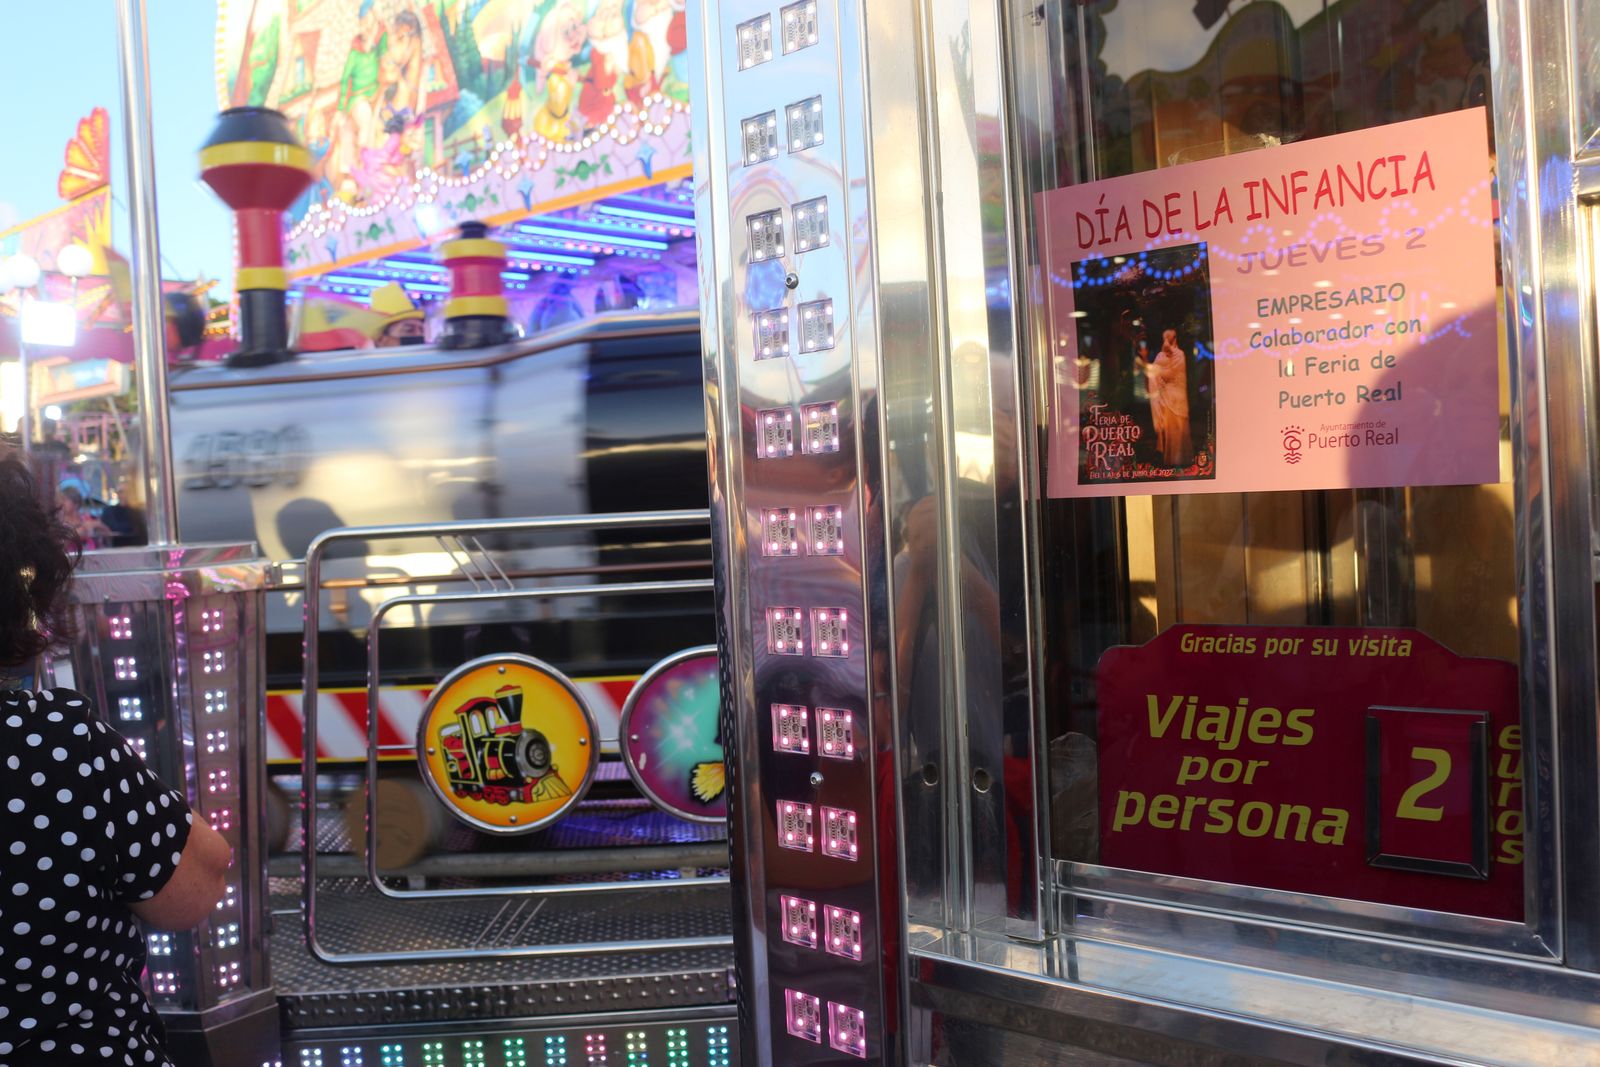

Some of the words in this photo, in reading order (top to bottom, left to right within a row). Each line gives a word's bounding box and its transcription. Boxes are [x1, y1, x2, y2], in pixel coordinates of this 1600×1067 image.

[1075, 193, 1132, 250] DÍA
[1143, 192, 1183, 238] DE
[1193, 187, 1233, 231] LA
[1243, 150, 1436, 222] INFANCIA
[1236, 234, 1386, 275] JUEVES
[1406, 226, 1428, 250] 2
[1256, 282, 1406, 318] EMPRESARIO
[1249, 322, 1374, 350] Colaborador
[1384, 317, 1422, 337] con
[1278, 358, 1296, 378] la
[1305, 354, 1360, 377] Feria
[1369, 350, 1397, 371] de
[1278, 388, 1346, 410] Puerto
[1356, 381, 1403, 403] Real
[1089, 403, 1118, 426] FERIA
[1120, 414, 1131, 424] DE
[1319, 420, 1374, 433] Ayuntamiento
[1375, 418, 1386, 429] de
[1082, 425, 1141, 452] PUERTO
[1308, 432, 1361, 449] Puerto
[1365, 427, 1399, 446] Real
[1090, 441, 1135, 471] REAL
[1180, 632, 1257, 655] Gracias
[1264, 636, 1304, 658] por
[1311, 638, 1340, 657] su
[1348, 635, 1413, 658] visita
[1145, 694, 1316, 751] Viajes
[1176, 755, 1270, 786] por
[1395, 746, 1453, 822] 2
[1112, 790, 1351, 847] persona
